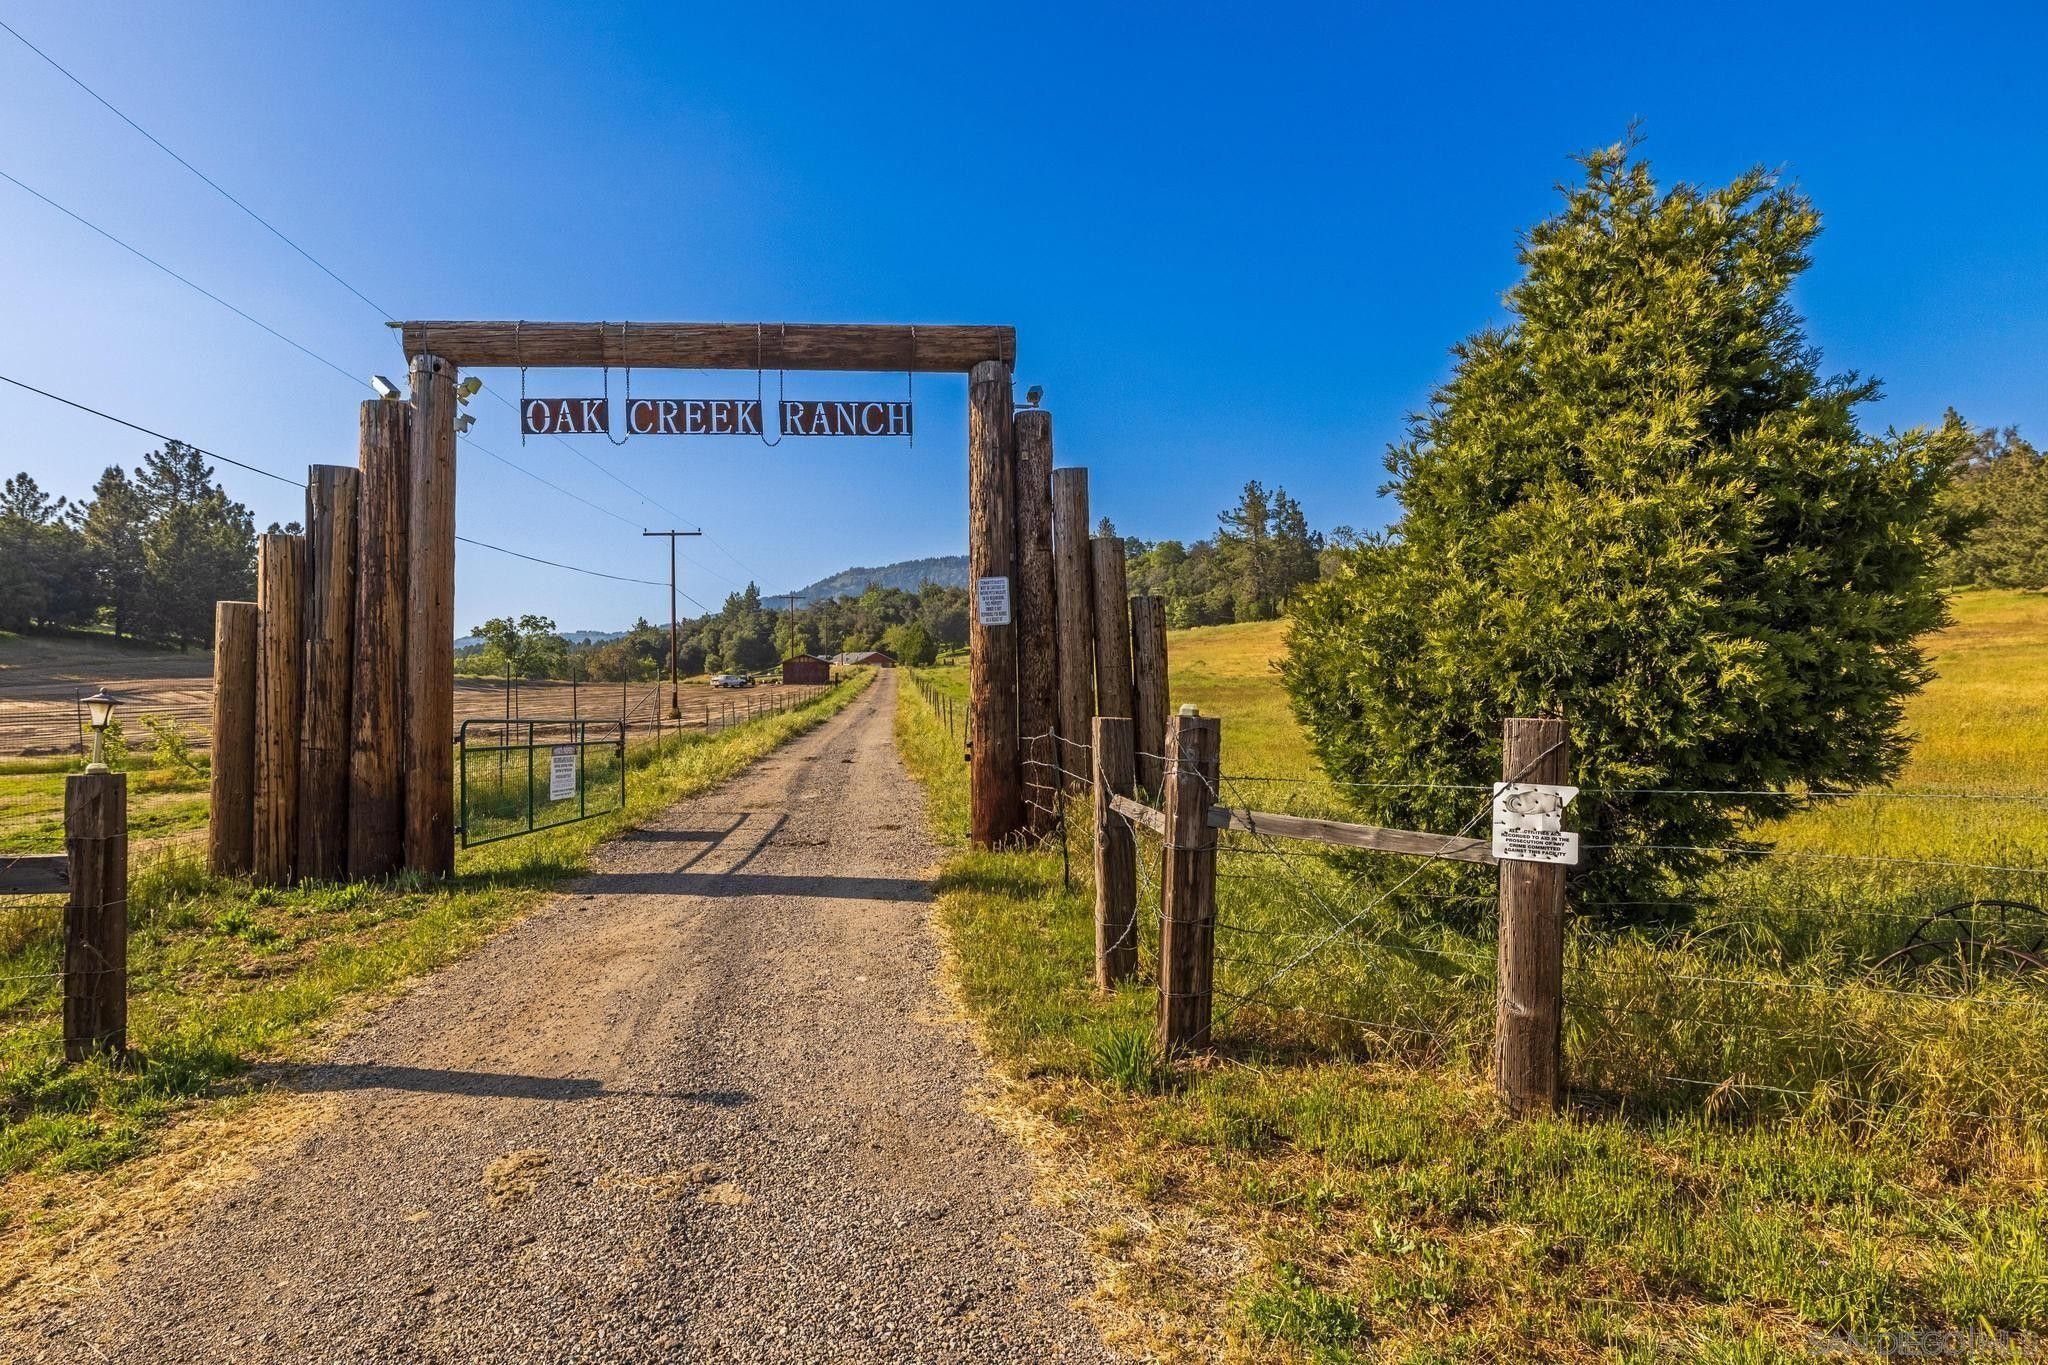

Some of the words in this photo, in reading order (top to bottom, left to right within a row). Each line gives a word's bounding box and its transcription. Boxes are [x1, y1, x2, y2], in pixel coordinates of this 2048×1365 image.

[526, 400, 605, 433] OAK
[630, 400, 759, 434] CREEK
[784, 402, 910, 435] RANCH
[1505, 837, 1544, 845] PROSECUTION
